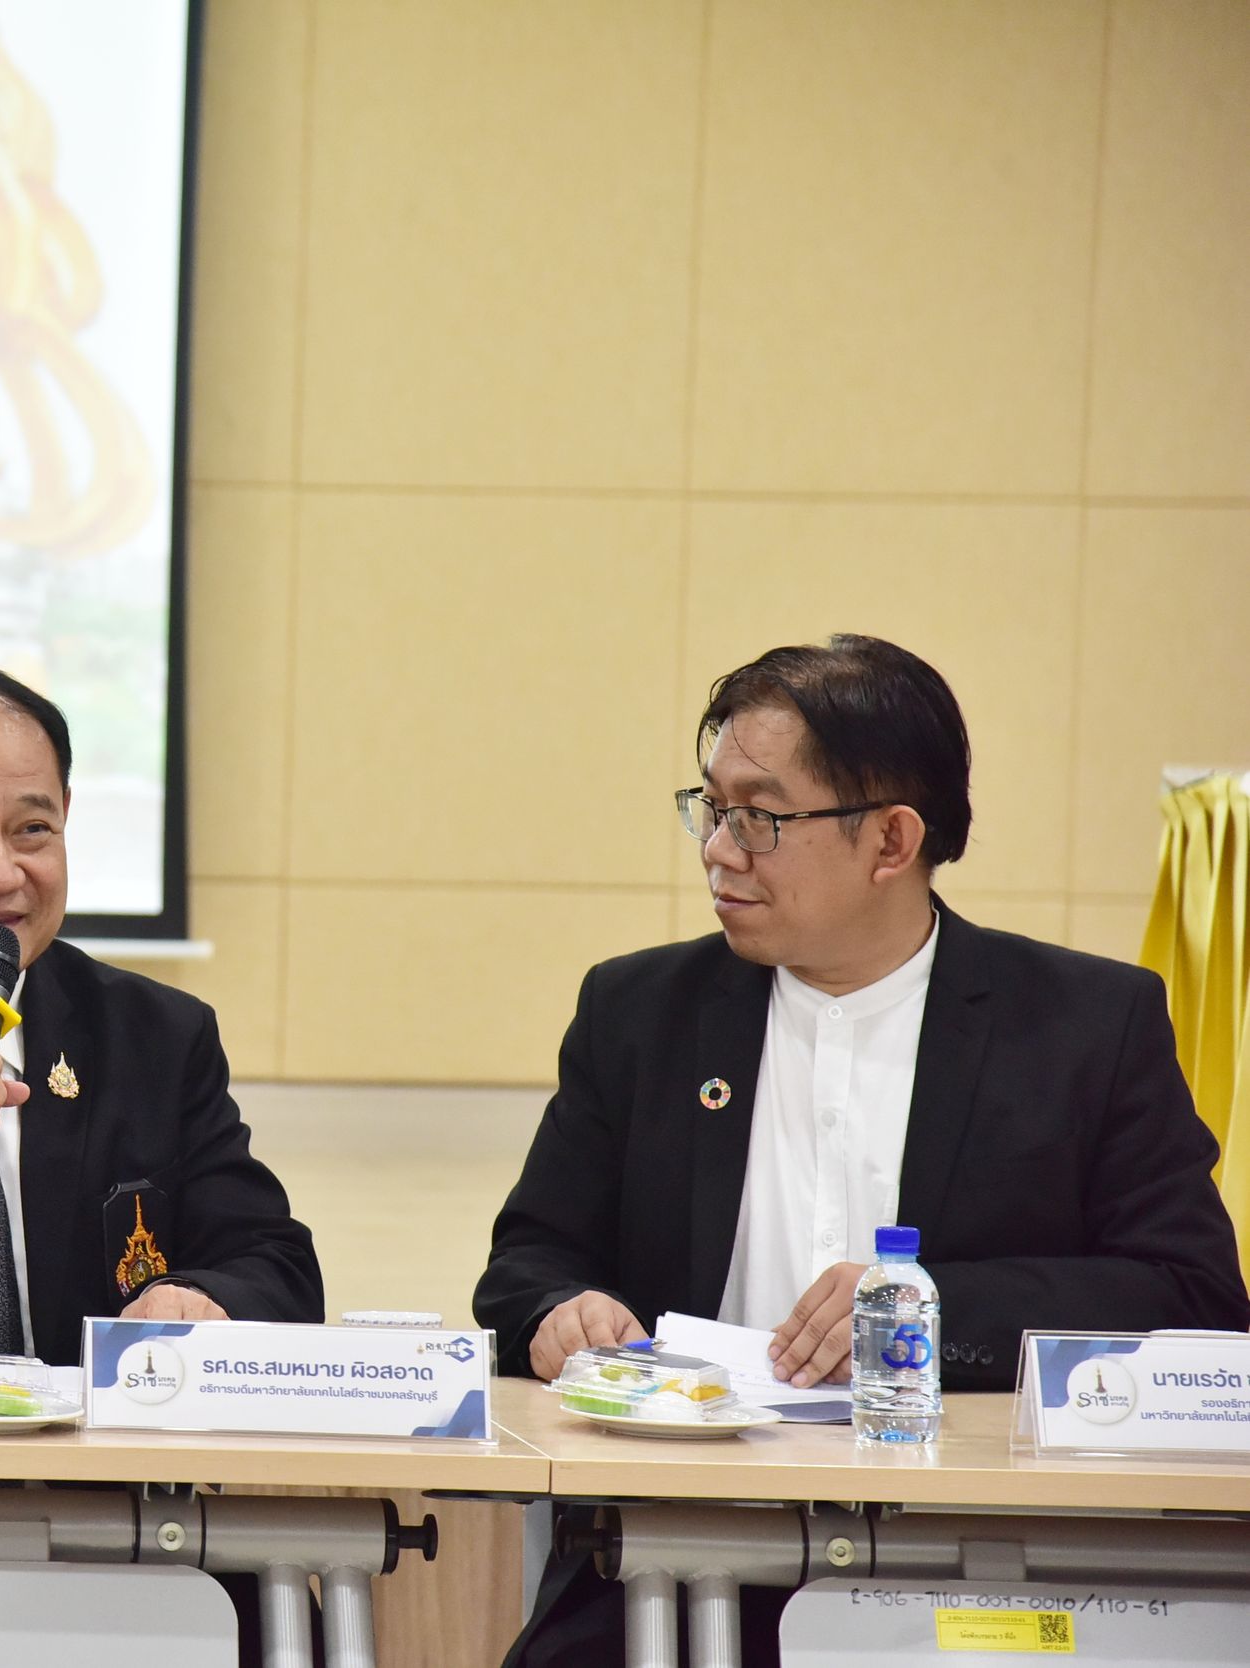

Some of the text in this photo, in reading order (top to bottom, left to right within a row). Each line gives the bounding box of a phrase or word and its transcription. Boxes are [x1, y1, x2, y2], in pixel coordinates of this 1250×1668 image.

[202, 1358, 434, 1381] รศ.ดร.สมหมาย ผิวสอาด
[1152, 1367, 1243, 1388] นายเรวัต
[199, 1383, 438, 1403] อธิการบดีมหาวิทยาลัยเทคโนโลยีราชมงคลธัญบุรี
